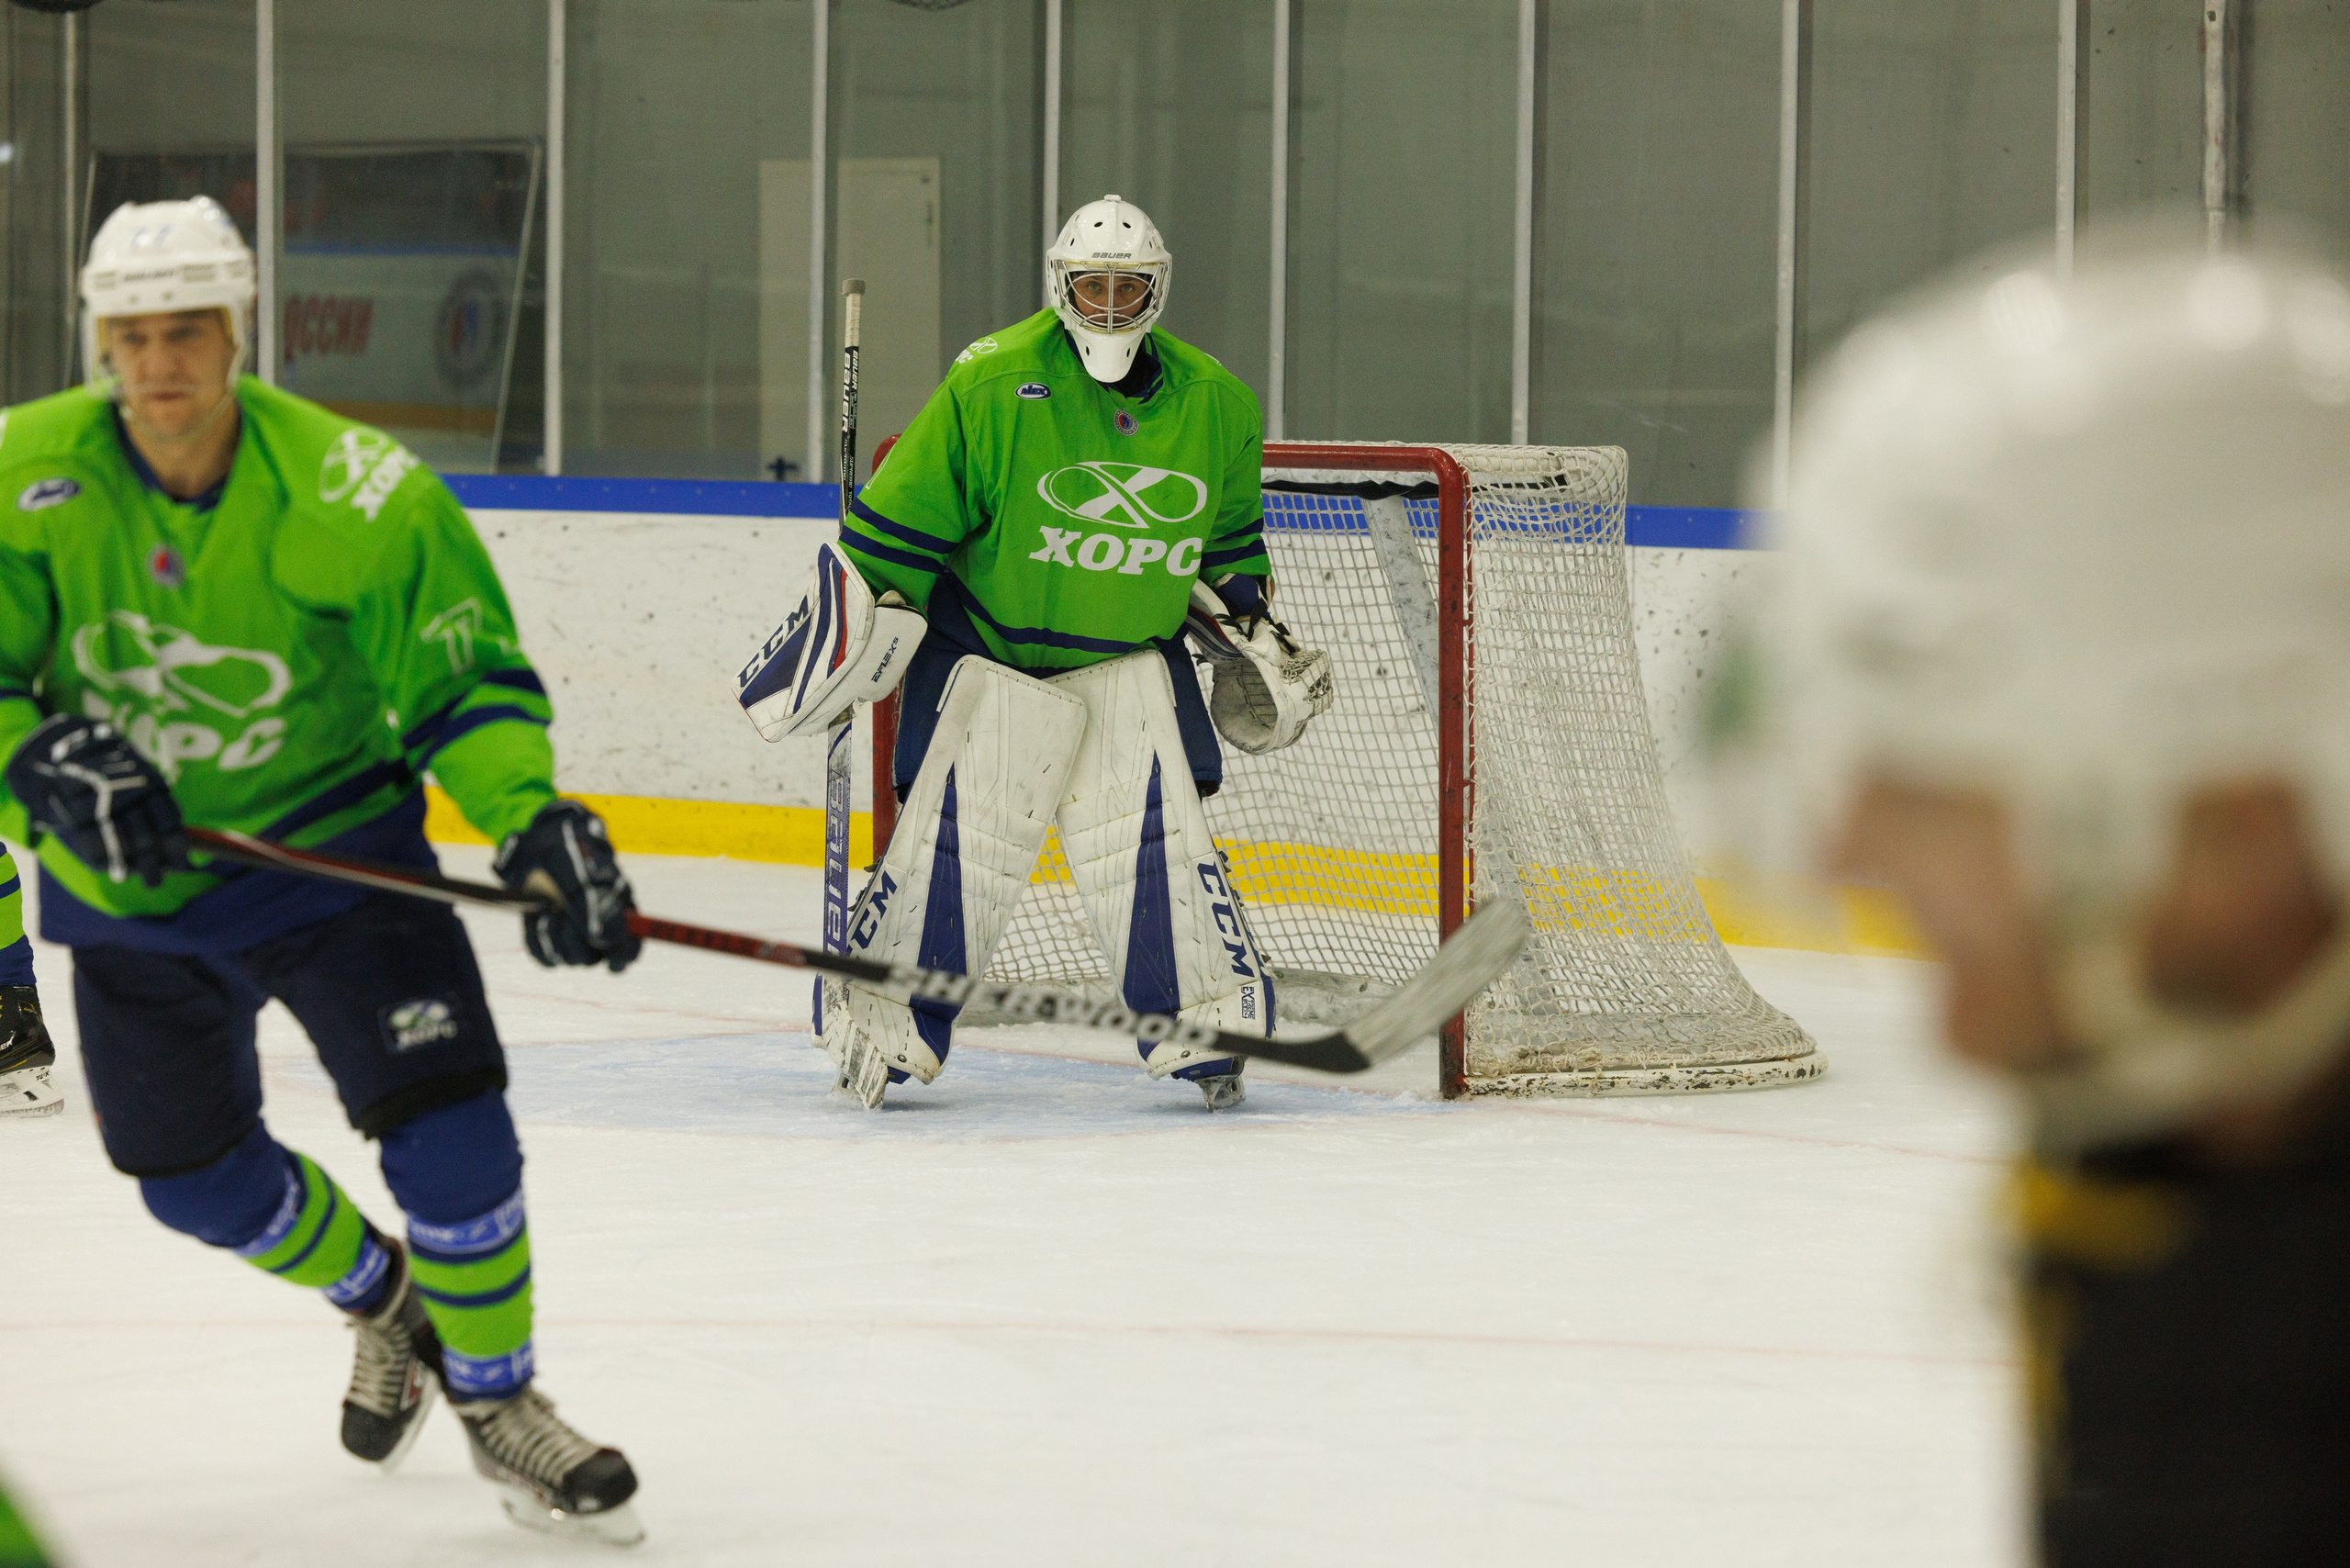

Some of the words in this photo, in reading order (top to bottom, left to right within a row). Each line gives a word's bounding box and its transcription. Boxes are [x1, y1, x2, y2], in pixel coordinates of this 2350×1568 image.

[842, 352, 851, 433] BAUER
[851, 350, 859, 390] BAUER
[1028, 525, 1203, 577] ХОРС
[737, 594, 809, 688] CCM
[846, 869, 898, 957] CM
[1197, 860, 1255, 978] CCM
